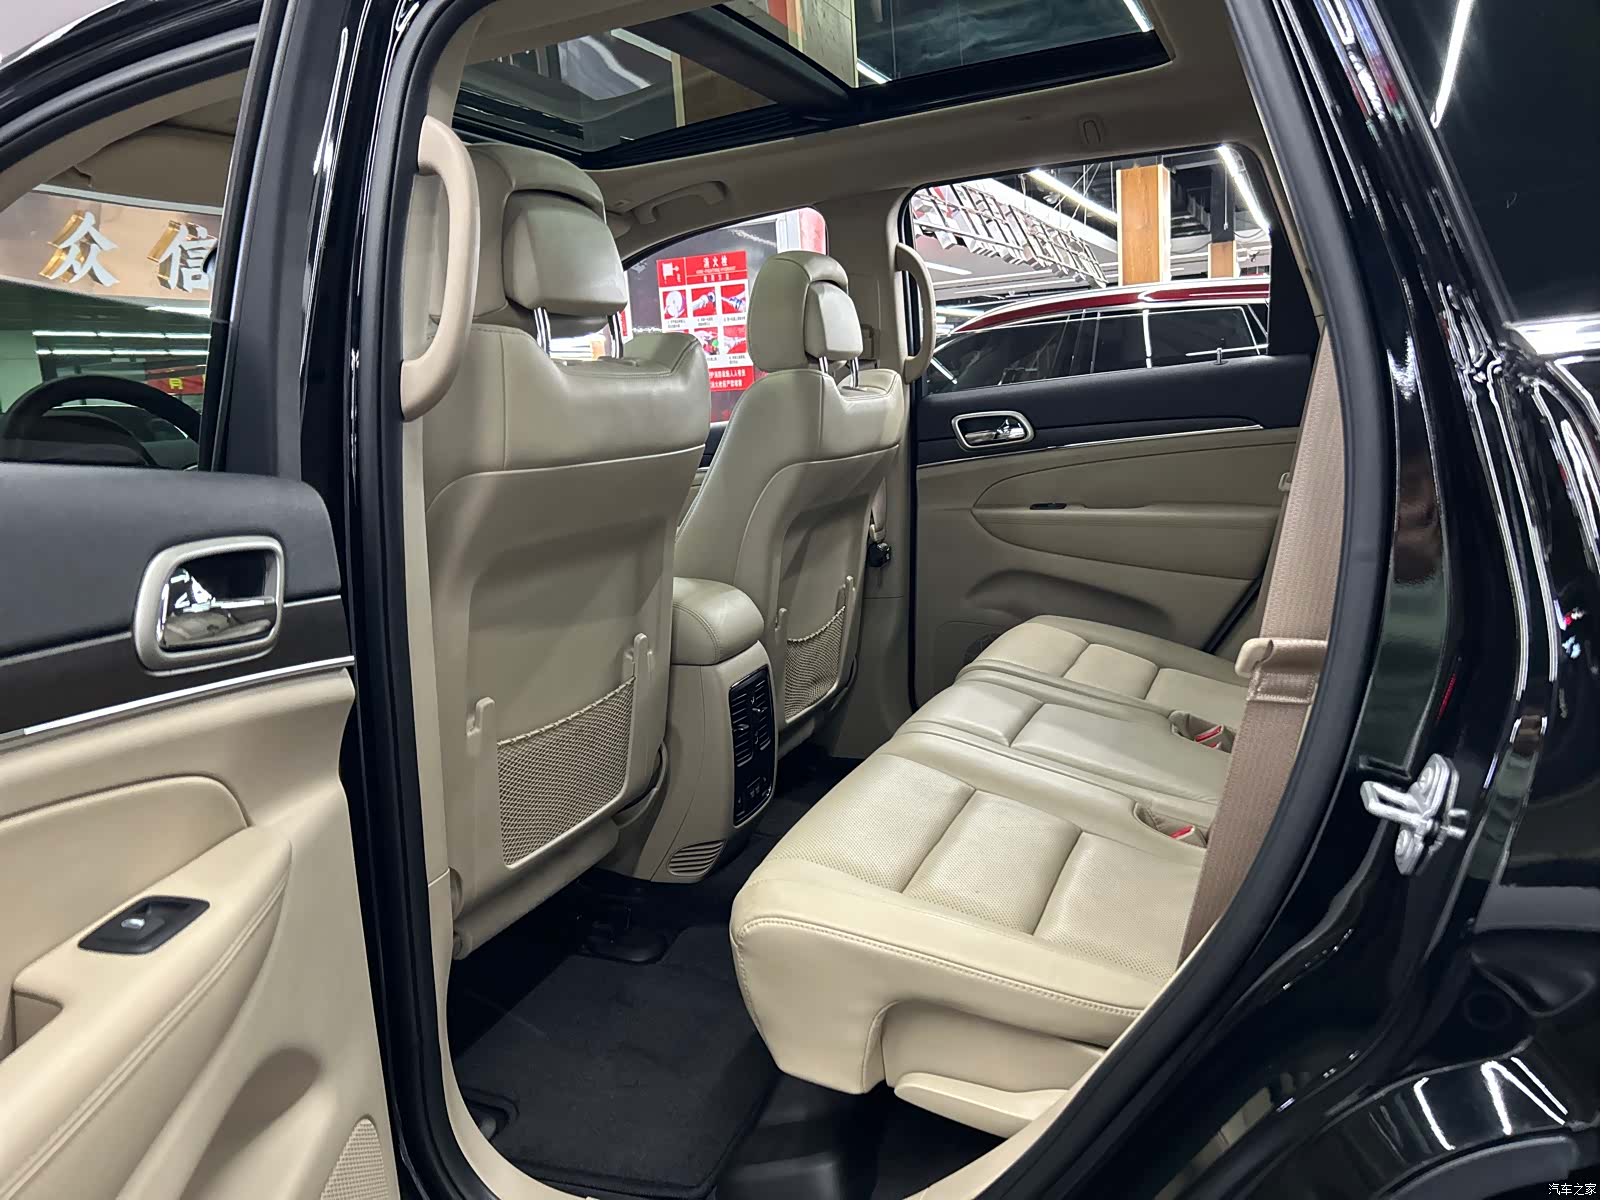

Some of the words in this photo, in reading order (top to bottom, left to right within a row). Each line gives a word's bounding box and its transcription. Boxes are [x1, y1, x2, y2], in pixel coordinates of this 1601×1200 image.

[45, 210, 218, 293] 众信
[703, 255, 728, 269] 消火栓
